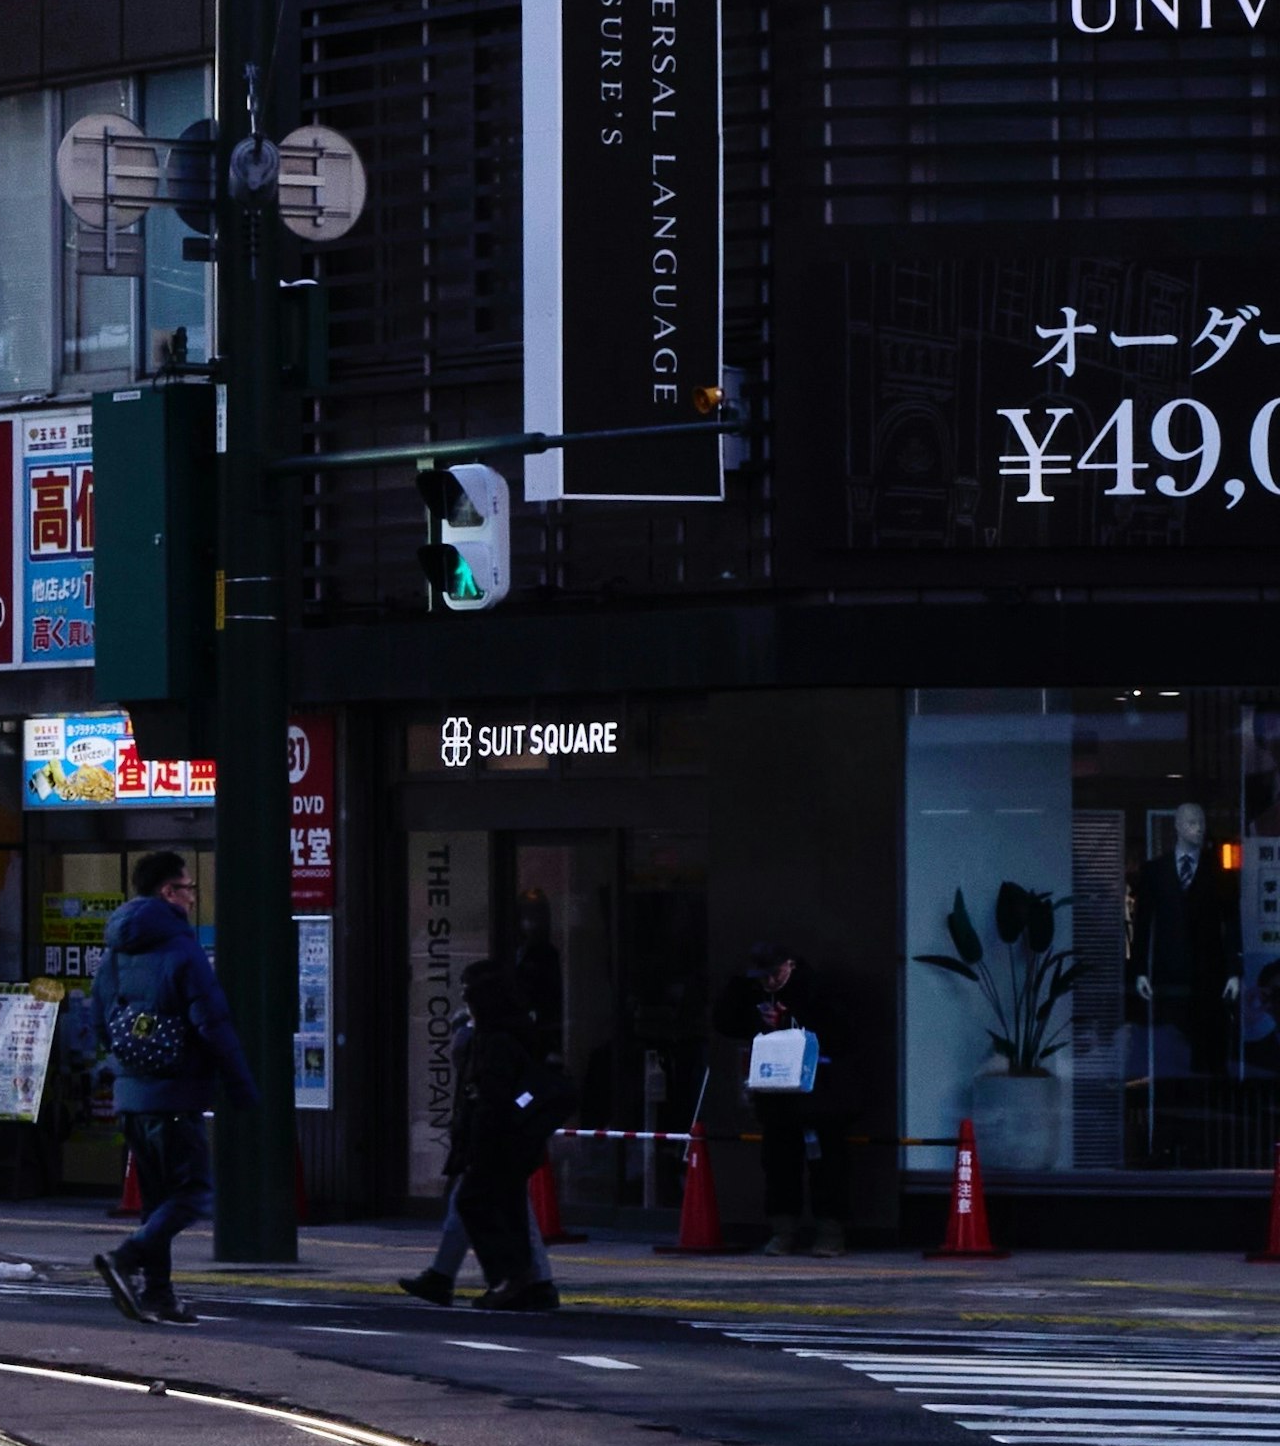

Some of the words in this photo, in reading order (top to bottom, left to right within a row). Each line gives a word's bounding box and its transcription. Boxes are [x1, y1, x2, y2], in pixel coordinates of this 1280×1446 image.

[651, 153, 679, 406] LANGUAGE
[478, 724, 527, 757] SUIT
[529, 721, 618, 755] SQUARE
[427, 844, 451, 906] THE
[427, 917, 452, 987] SUIT
